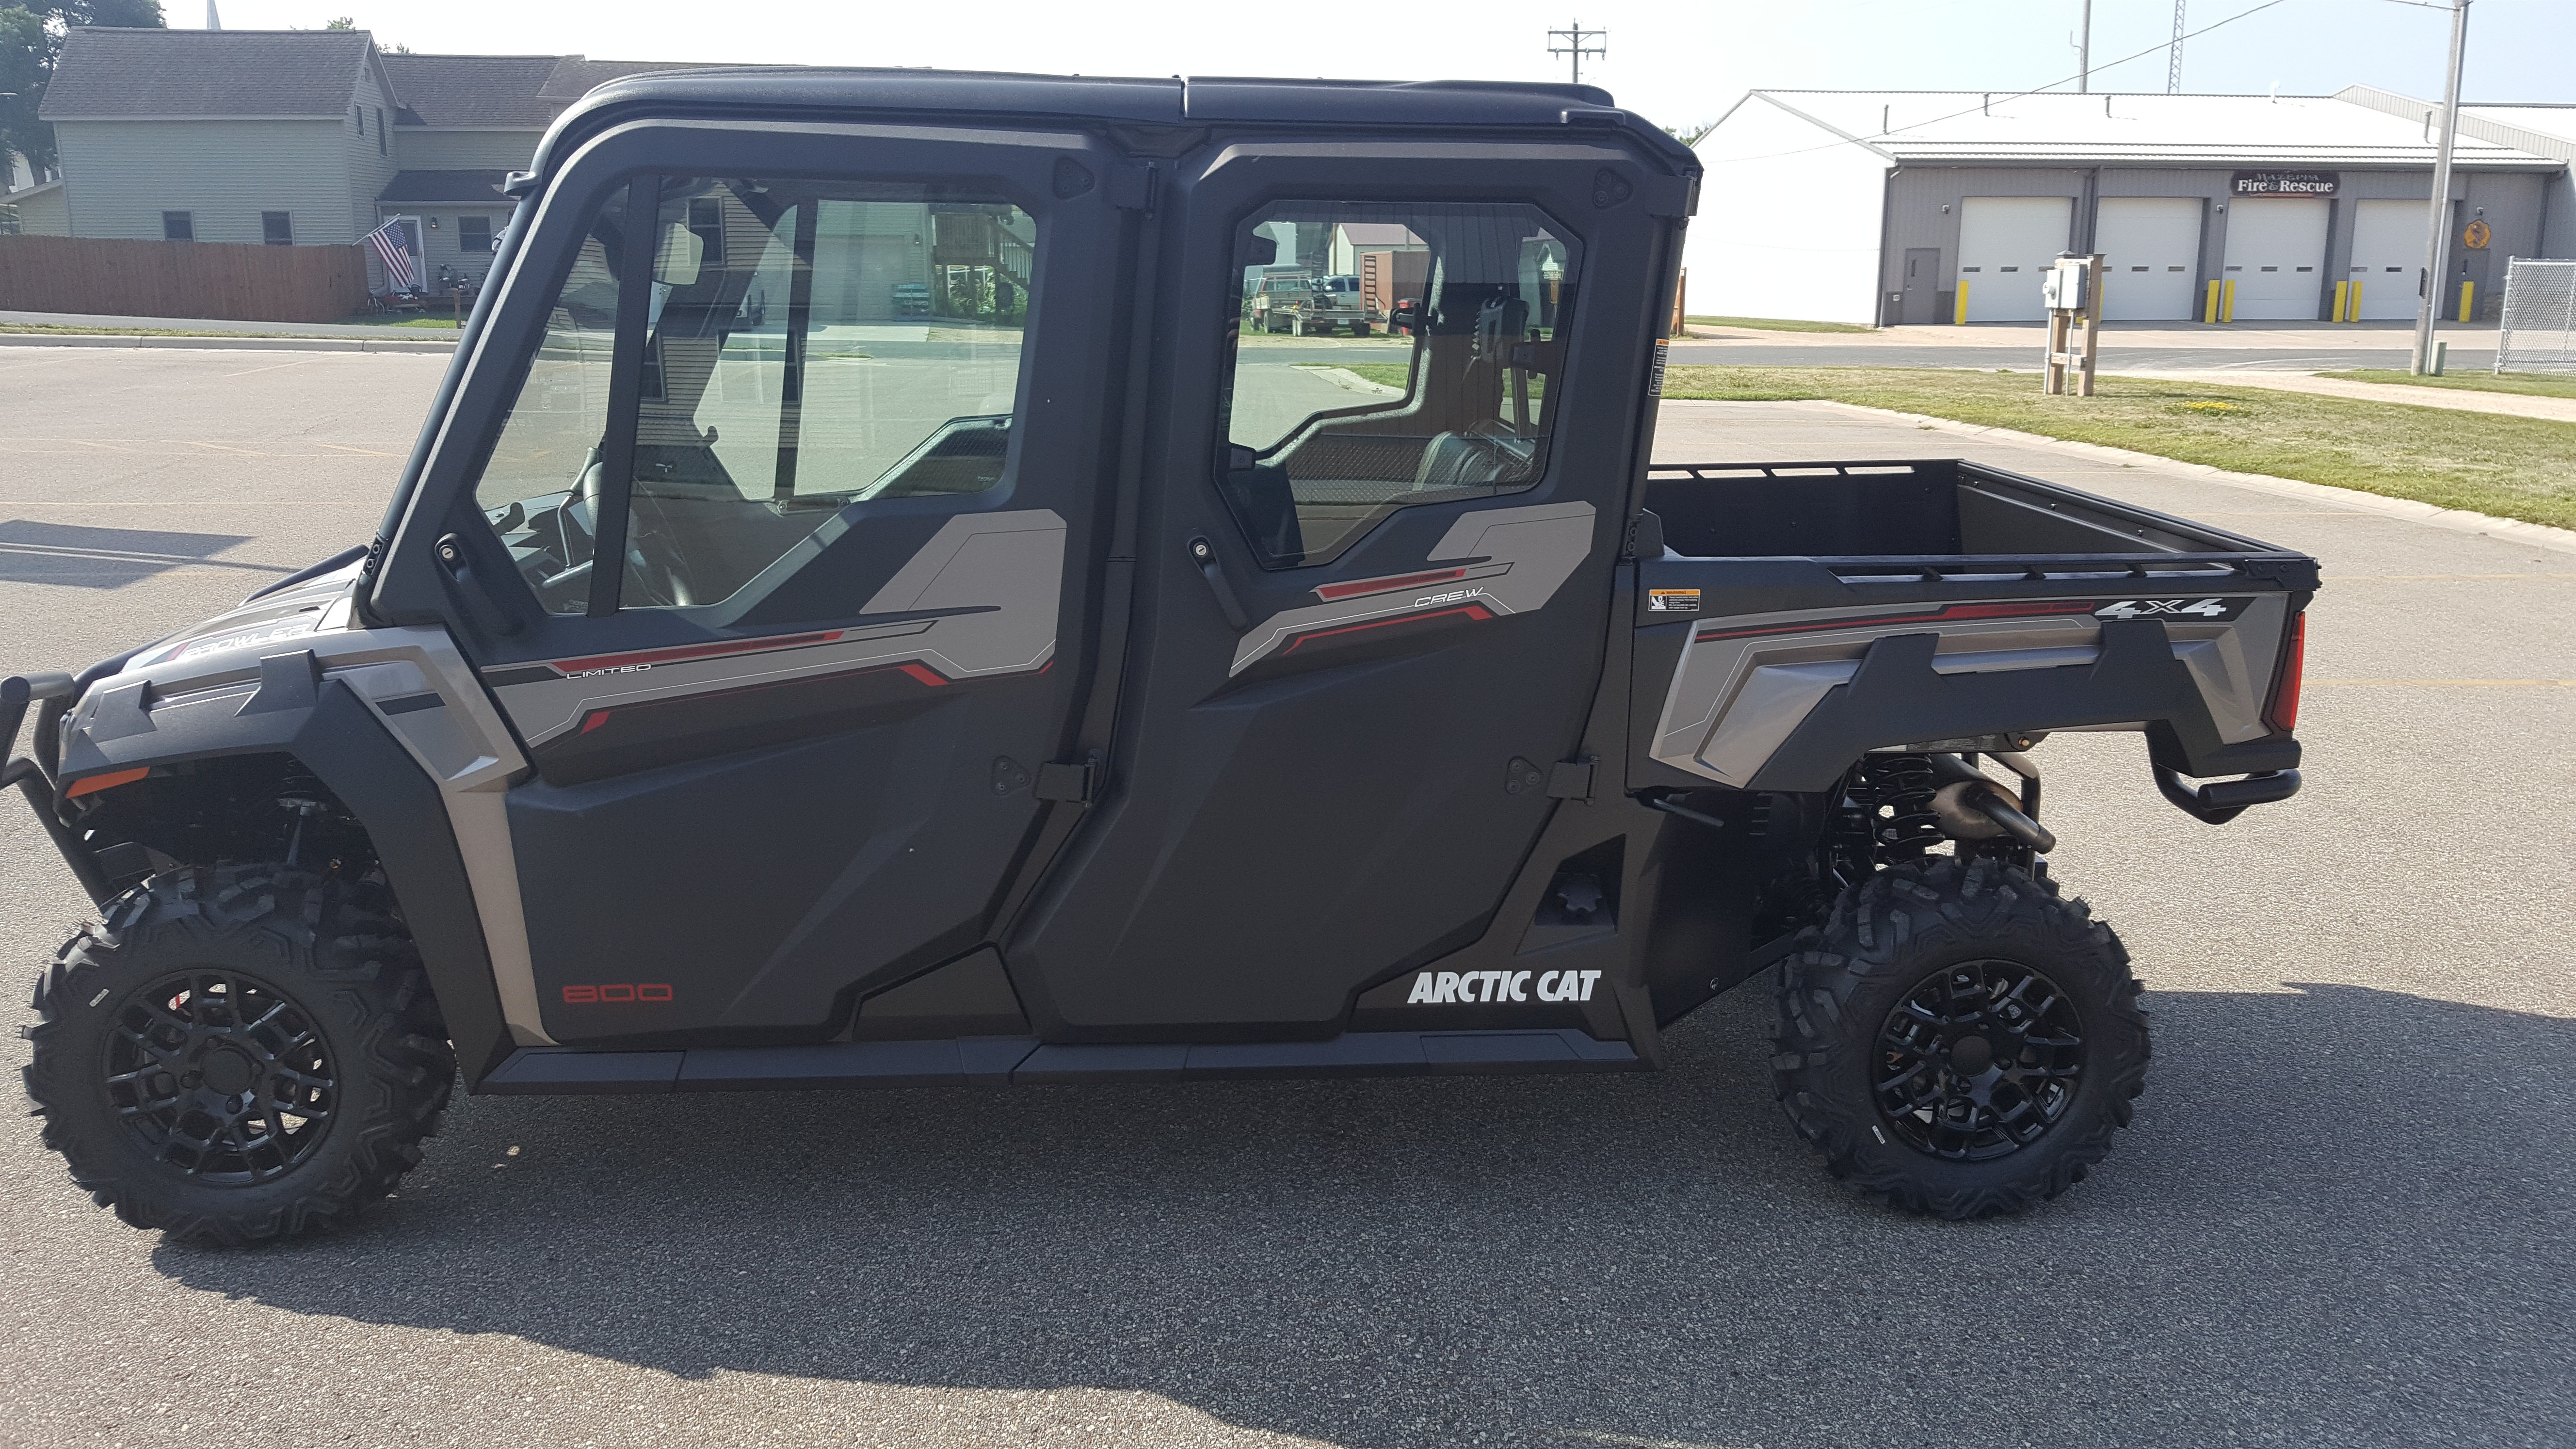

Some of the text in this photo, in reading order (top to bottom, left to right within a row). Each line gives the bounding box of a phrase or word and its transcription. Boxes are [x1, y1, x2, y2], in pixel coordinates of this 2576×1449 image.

[2238, 179, 2268, 192] Fire
[2279, 180, 2334, 192] Rescue
[1414, 587, 1484, 607] CREW
[184, 624, 311, 655] PROWLER
[566, 664, 651, 679] LIMITED
[563, 984, 673, 1002] 800
[1407, 970, 1602, 1003] ARCTIC CAT
